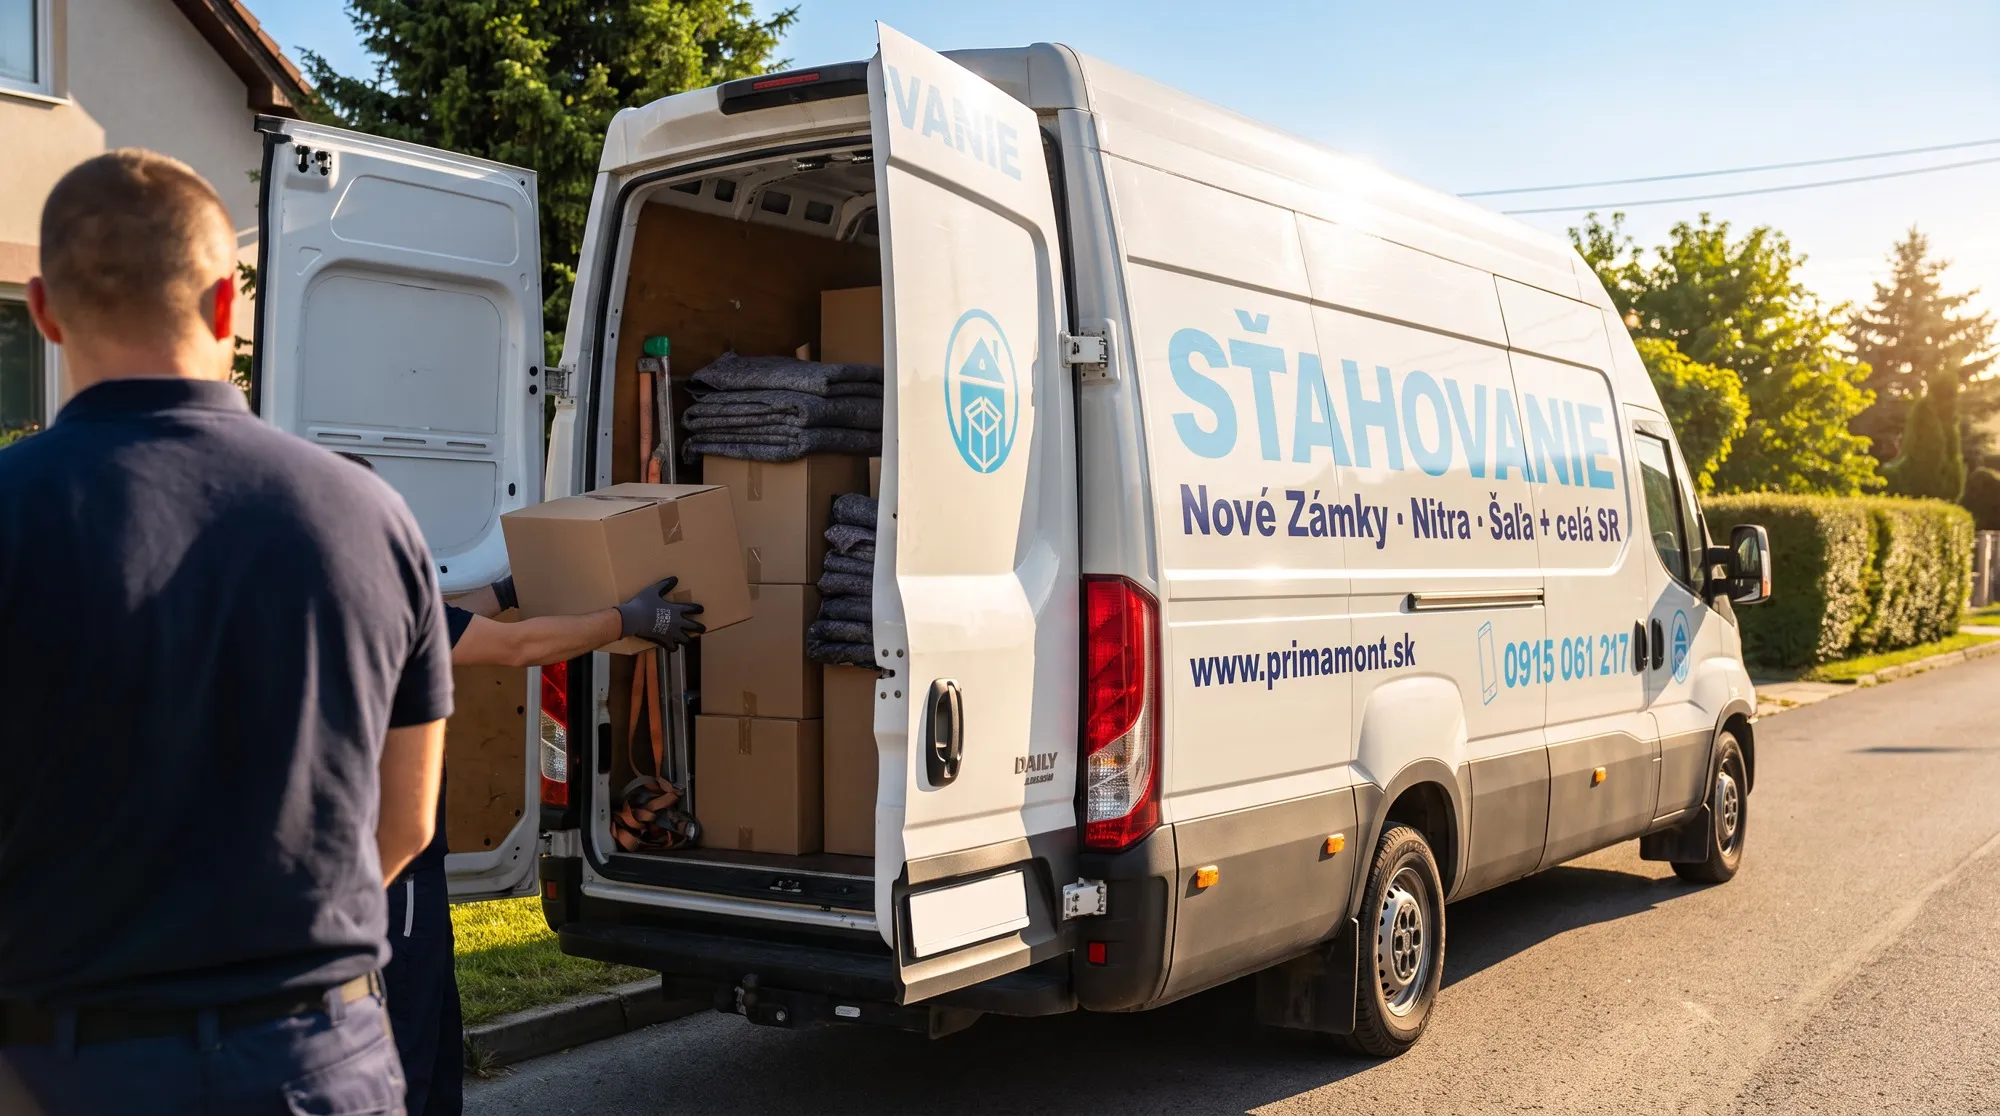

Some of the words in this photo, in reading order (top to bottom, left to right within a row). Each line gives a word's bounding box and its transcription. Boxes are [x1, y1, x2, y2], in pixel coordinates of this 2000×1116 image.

[884, 64, 1022, 181] VANIE
[1168, 308, 1616, 490] SŤAHOVANIE
[1180, 484, 1277, 537] Nové
[1285, 489, 1388, 550] Zámky
[1410, 498, 1471, 540] Nitra
[1489, 492, 1534, 541] Šaľa
[1557, 506, 1594, 542] celá
[1597, 508, 1621, 542] SR
[1190, 632, 1416, 690] www.primamont.sk
[1504, 639, 1555, 689] 0915
[1560, 635, 1594, 681] 061
[1599, 633, 1630, 676] 217
[1014, 751, 1058, 775] DAILY
